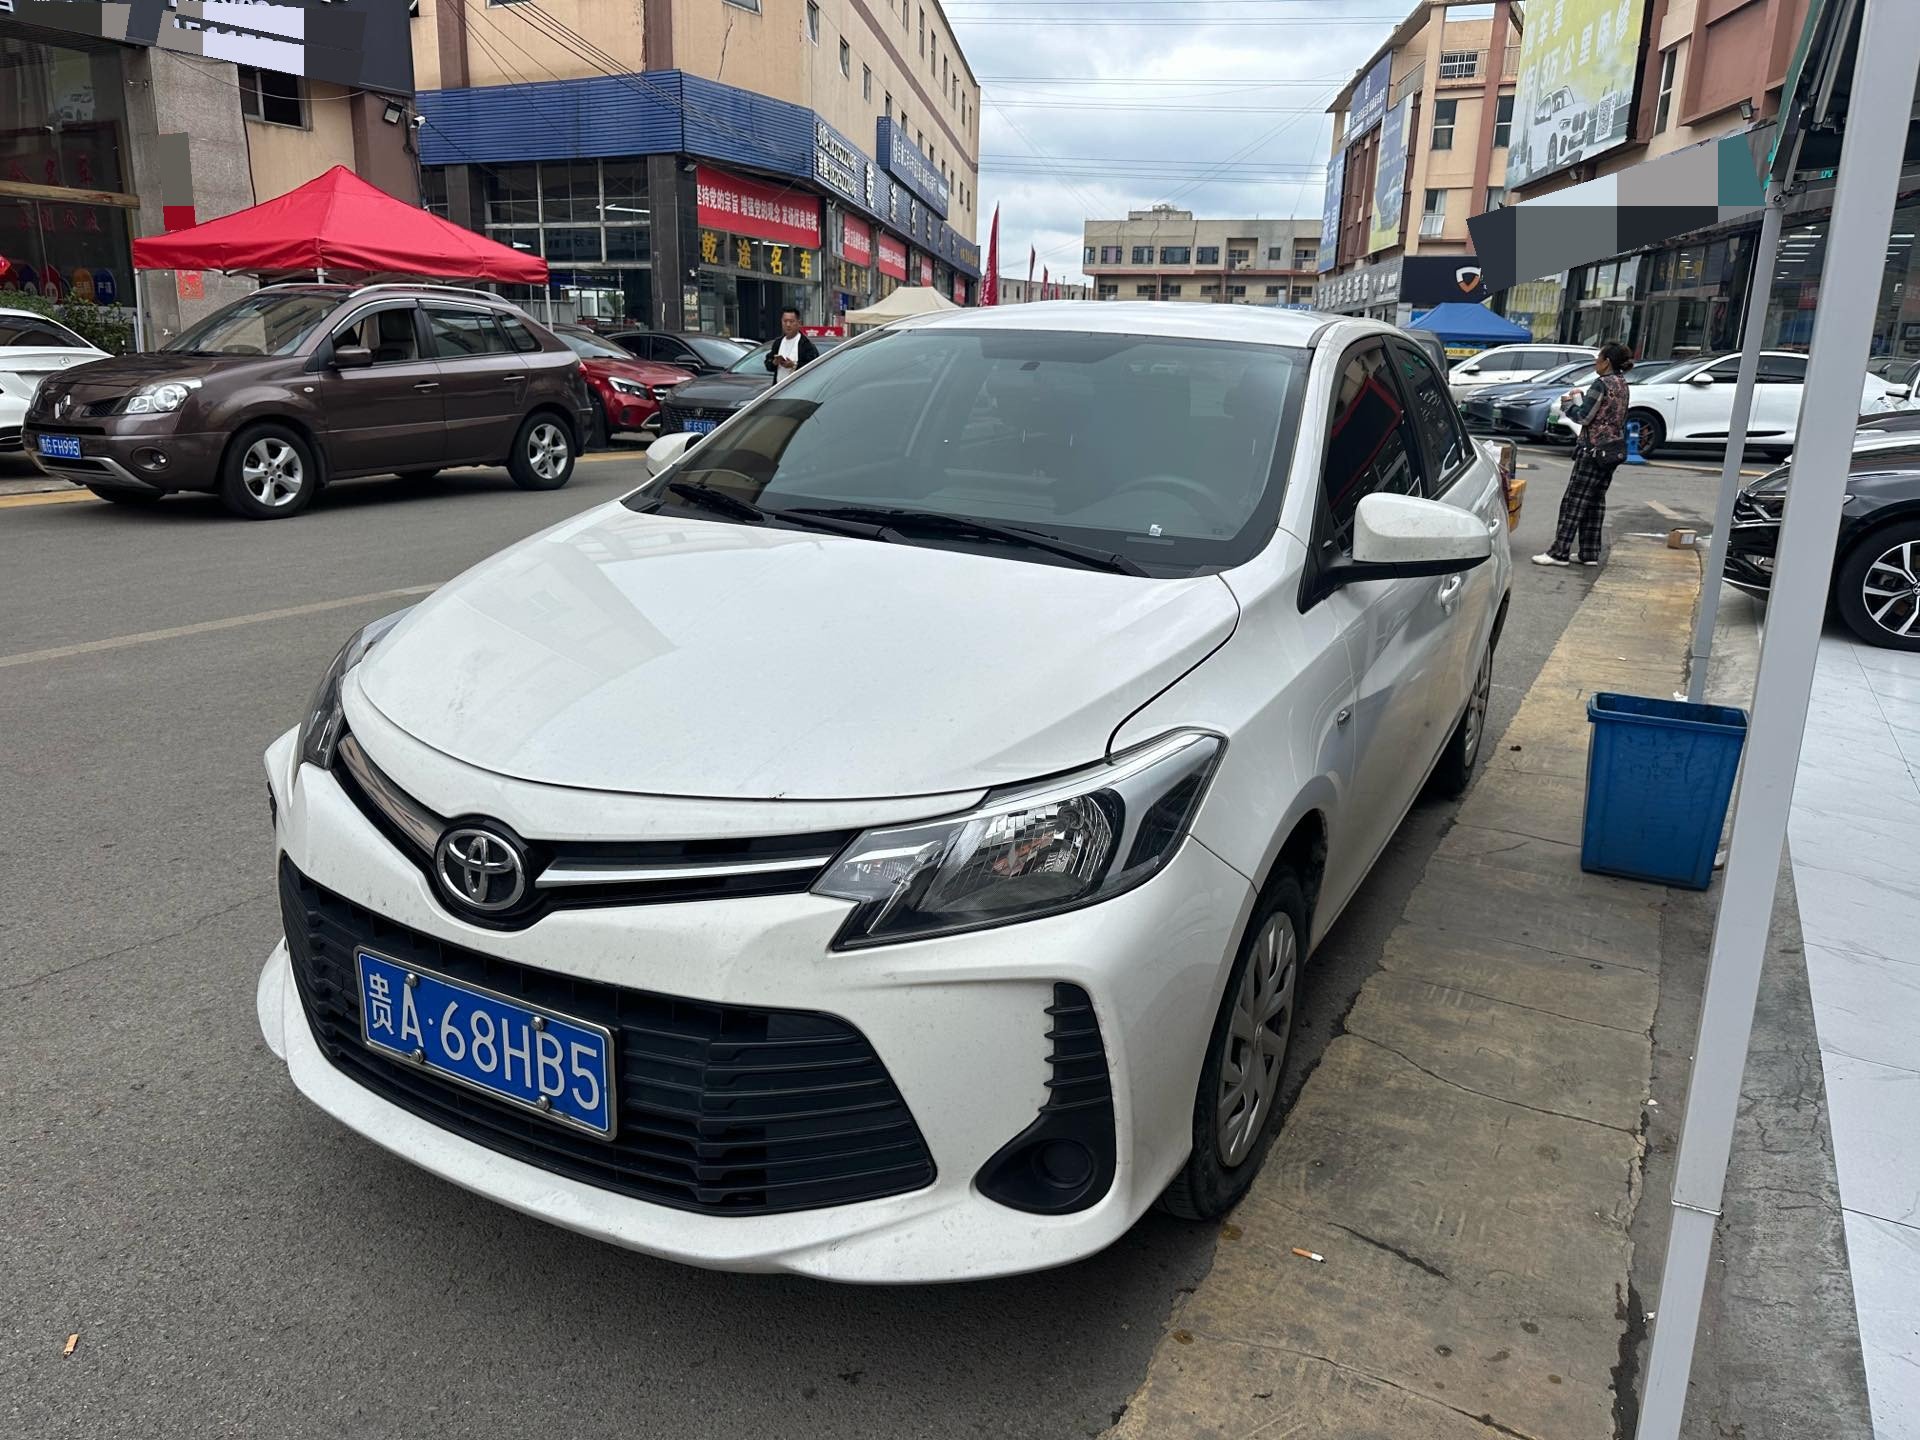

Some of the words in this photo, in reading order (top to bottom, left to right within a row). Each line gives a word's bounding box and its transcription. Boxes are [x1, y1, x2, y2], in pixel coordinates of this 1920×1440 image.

[701, 230, 812, 279] 乾途名车
[368, 972, 600, 1111] 贵A·68HB5
